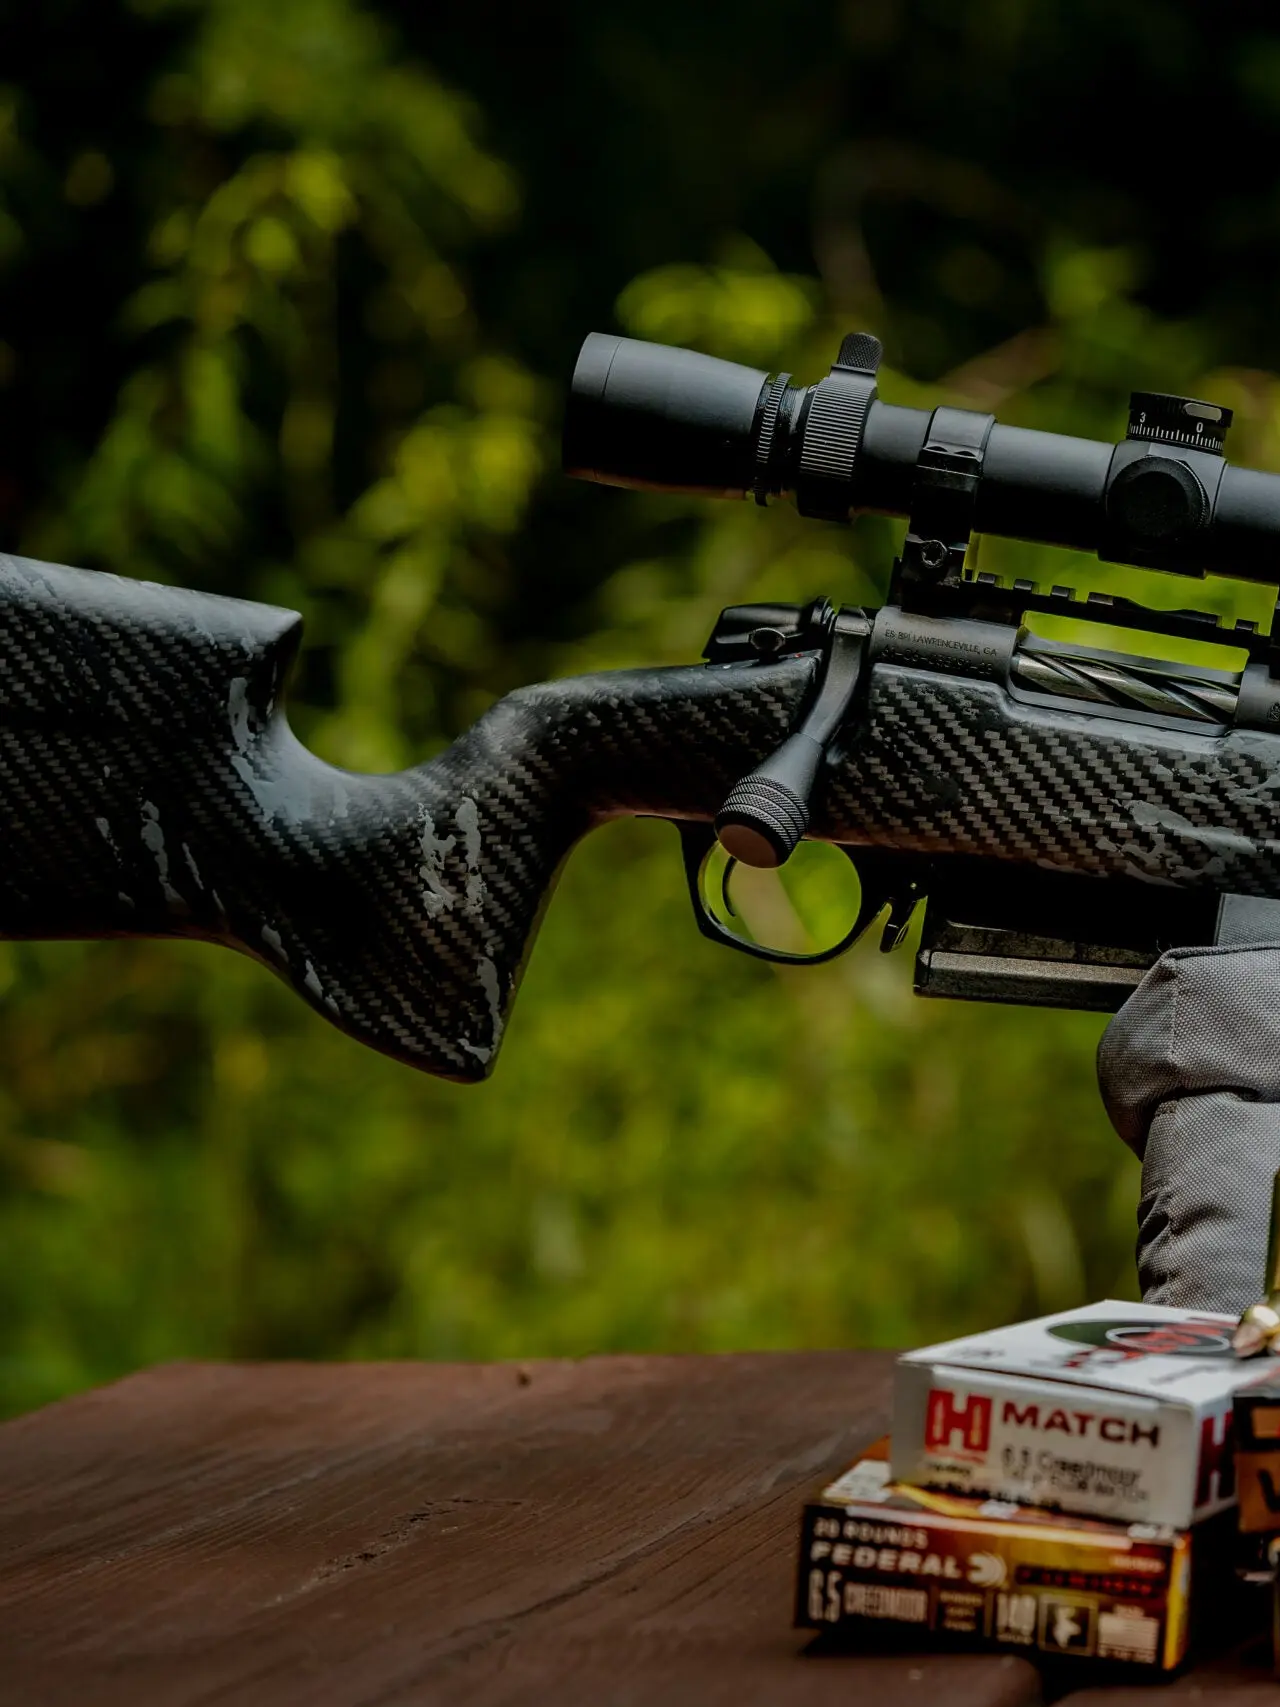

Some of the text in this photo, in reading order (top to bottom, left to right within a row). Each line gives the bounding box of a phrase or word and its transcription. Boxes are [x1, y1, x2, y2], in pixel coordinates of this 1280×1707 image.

[1140, 411, 1203, 433] 3 0
[1001, 1401, 1161, 1449] MATCH
[842, 1519, 929, 1550] ROUNDS
[810, 1541, 962, 1579] FEDERAL
